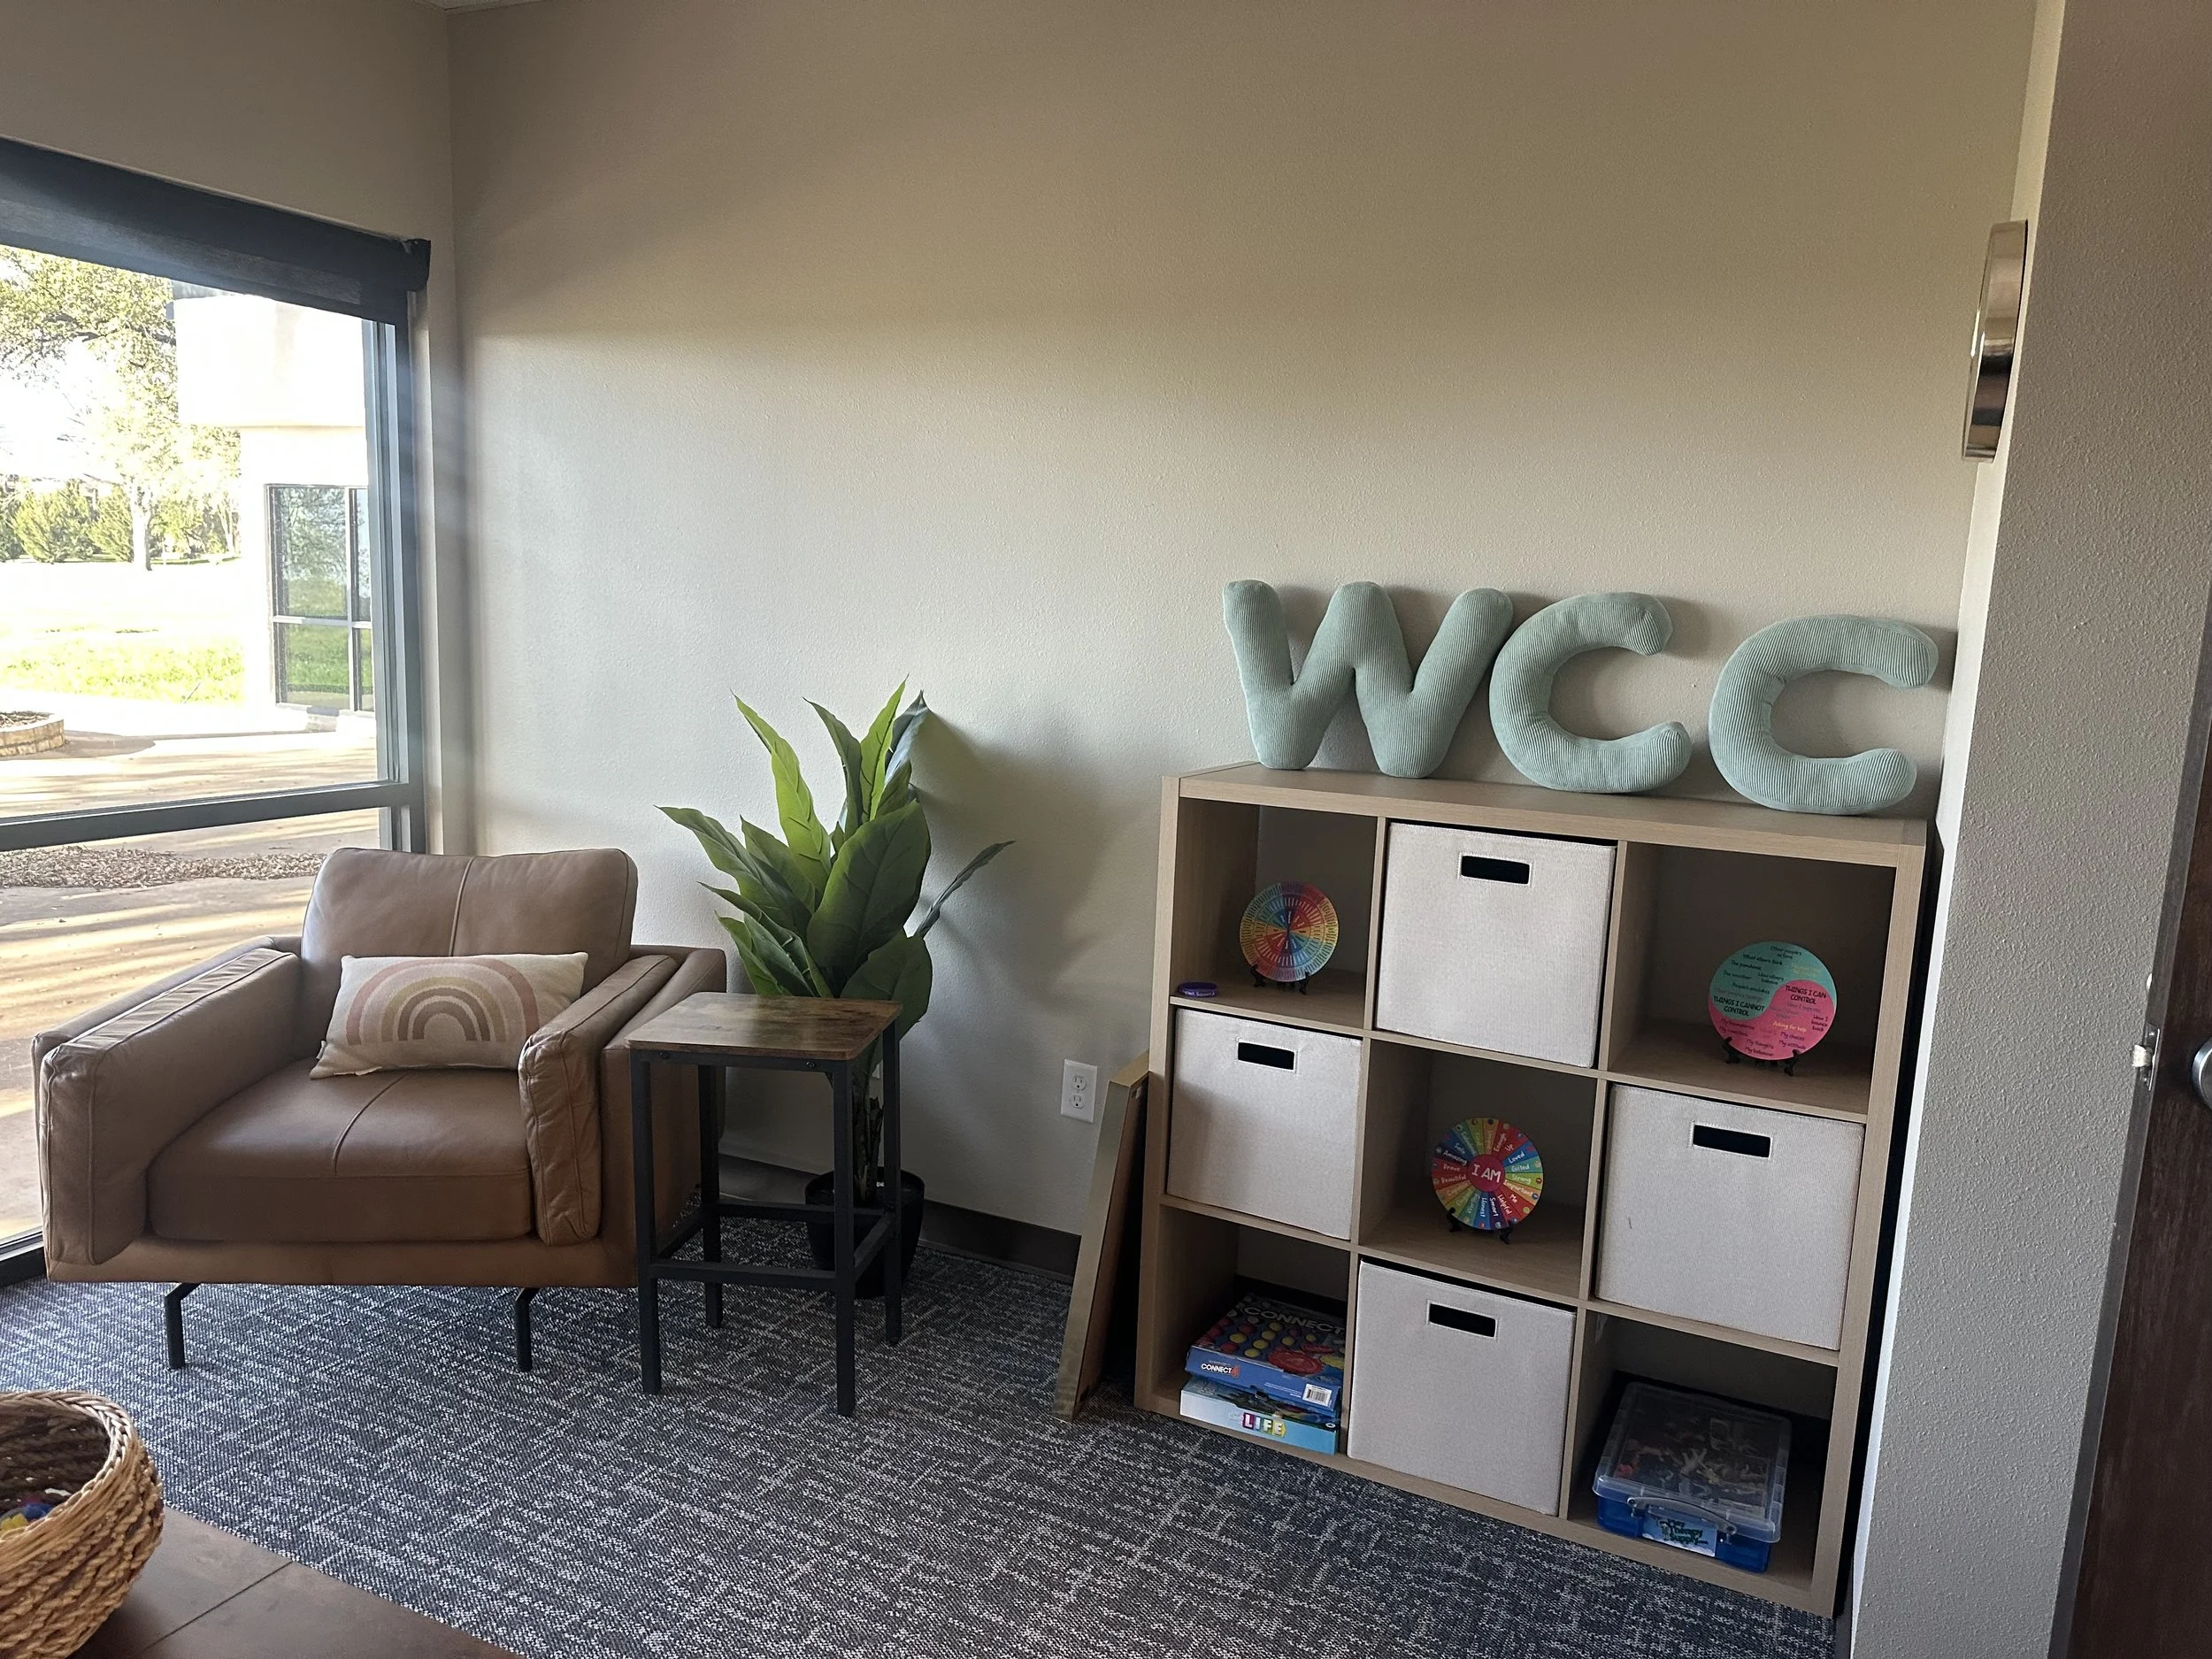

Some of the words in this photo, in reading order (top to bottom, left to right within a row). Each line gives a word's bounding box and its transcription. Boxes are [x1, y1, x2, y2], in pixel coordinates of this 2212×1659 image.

[1785, 985, 1809, 996] THINGS
[1813, 990, 1827, 999] CAN
[1790, 994, 1816, 1005] CONTROL
[1713, 995, 1735, 1006] THINGS
[1740, 1002, 1765, 1012] CANNOT
[1724, 1005, 1749, 1017] CONTROL
[1454, 1142, 1466, 1155] Safe
[1443, 1150, 1468, 1166] Amazing
[1508, 1152, 1525, 1164] Loved
[1440, 1175, 1467, 1184] Beautiful
[1471, 1164, 1480, 1177] I
[1480, 1167, 1502, 1183] AM
[1511, 1175, 1532, 1185] Strong
[1503, 1179, 1533, 1196] Important
[1489, 1197, 1499, 1217] Smart
[1498, 1194, 1513, 1215] Helpful
[1243, 1306, 1346, 1335] CONNECT
[1201, 1363, 1233, 1374] CONNECT
[1243, 1413, 1284, 1436] LIFE
